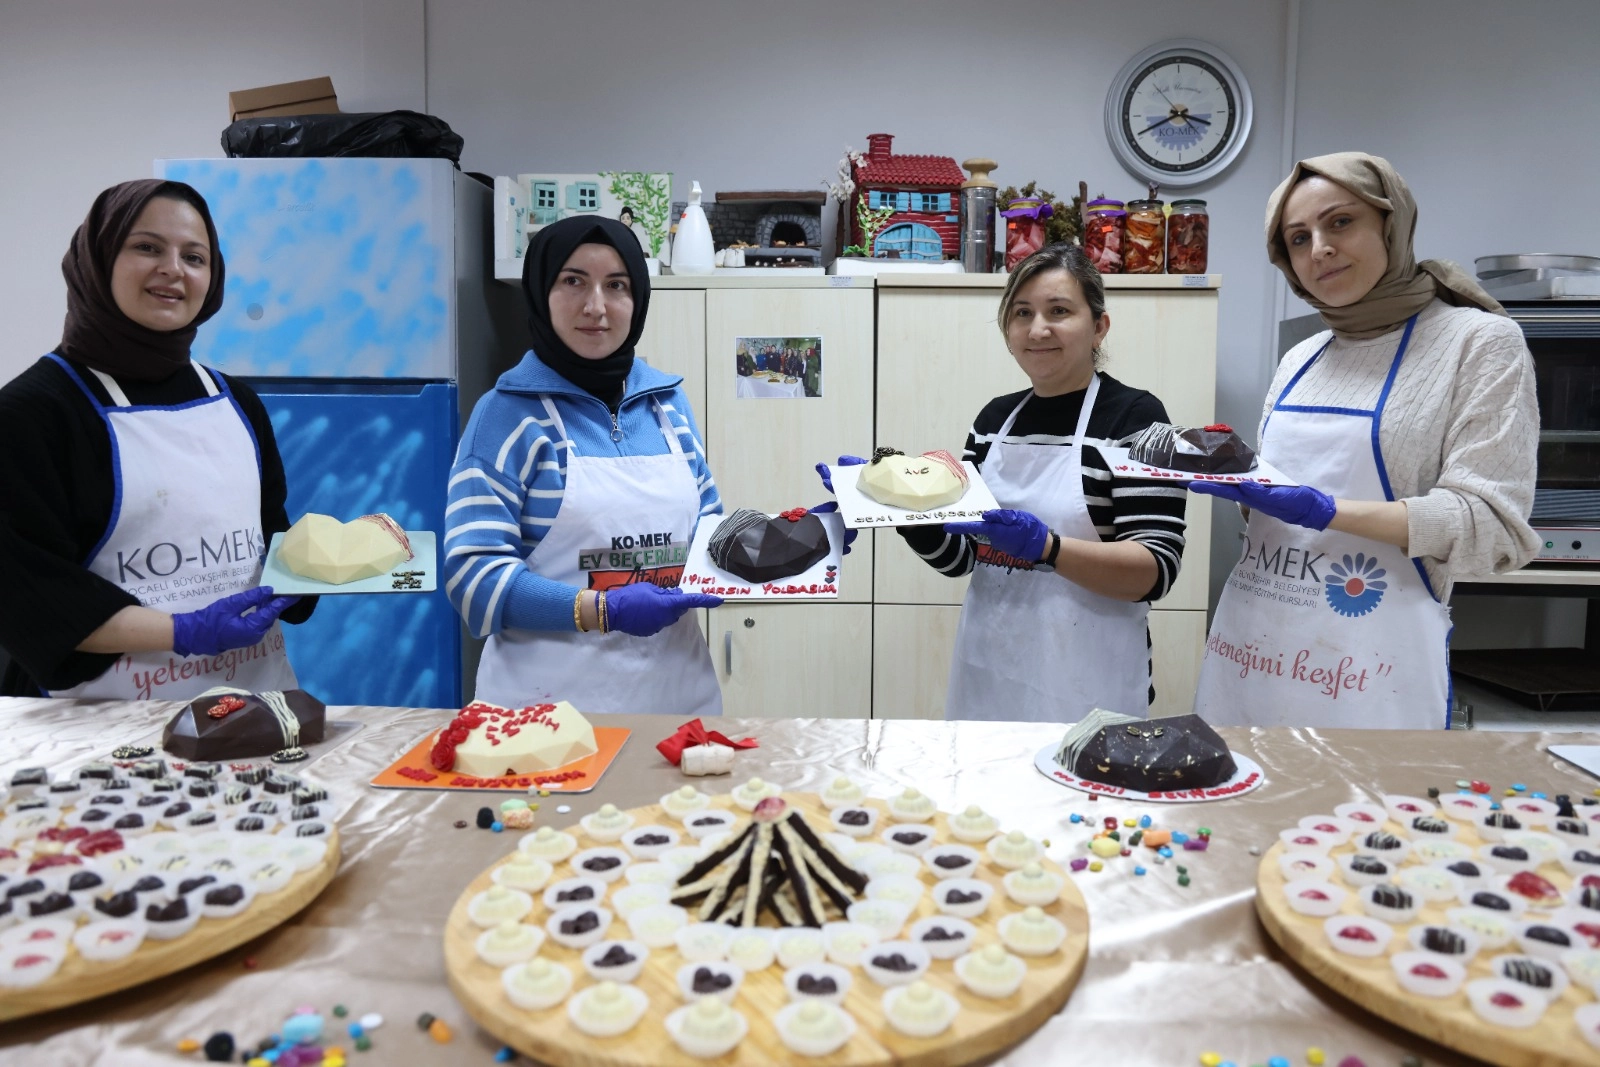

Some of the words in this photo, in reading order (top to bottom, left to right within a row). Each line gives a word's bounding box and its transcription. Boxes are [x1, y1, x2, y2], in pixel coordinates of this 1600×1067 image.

[611, 532, 673, 550] KO-MEK
[117, 526, 258, 584] KO-MEK
[579, 553, 603, 570] EV
[126, 580, 170, 597] OCAELİ
[173, 568, 229, 589] BÜYÜKŞEHİR
[1273, 580, 1320, 598] BELEDİYESİ
[180, 586, 211, 599] SANAT
[1278, 593, 1318, 609] KURSLARI
